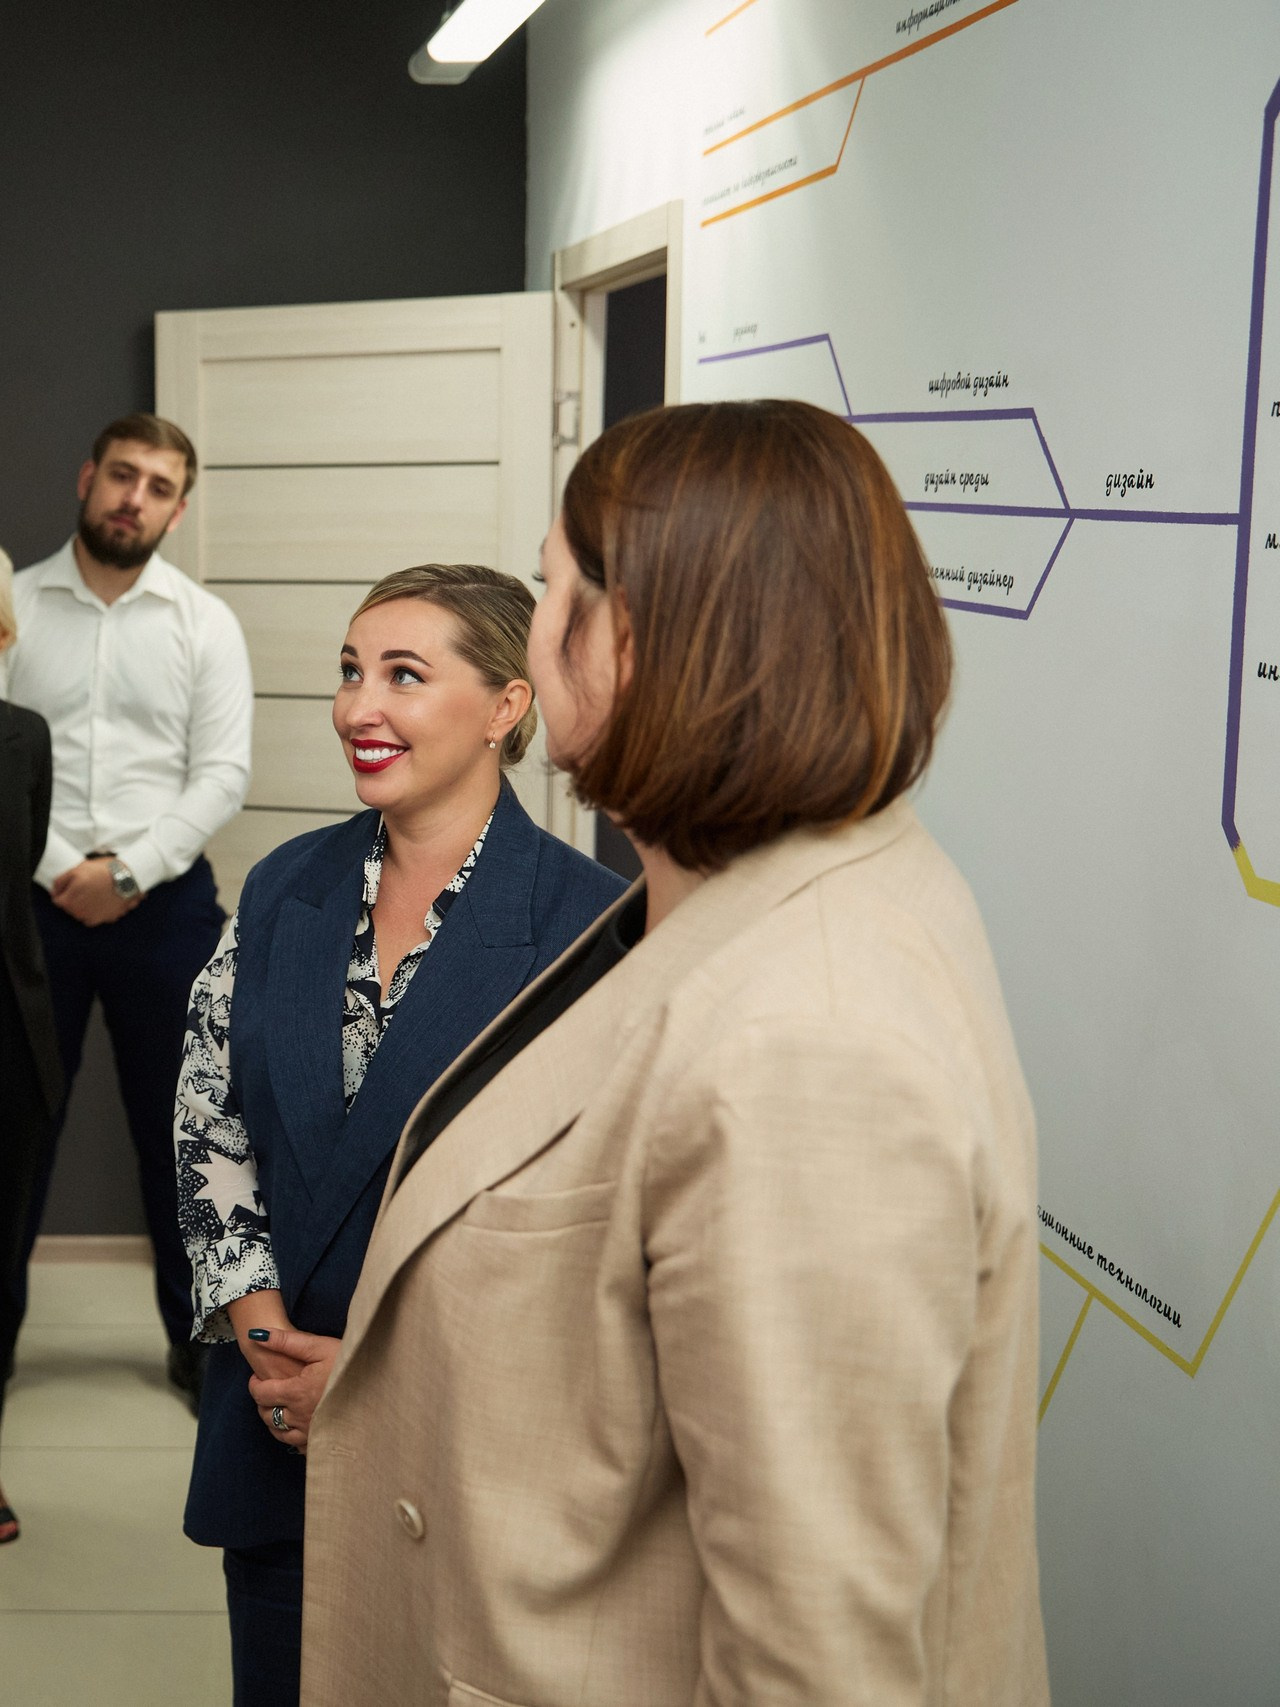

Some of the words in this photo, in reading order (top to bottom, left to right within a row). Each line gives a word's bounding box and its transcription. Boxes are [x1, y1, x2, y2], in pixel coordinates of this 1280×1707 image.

[928, 371, 971, 398] цифровой
[972, 370, 1009, 397] дизайн
[924, 468, 957, 493] дизайн
[959, 473, 989, 493] среды
[1105, 468, 1155, 498] дизайн
[966, 569, 1014, 596] дизайнер
[1096, 1253, 1182, 1328] технологии
